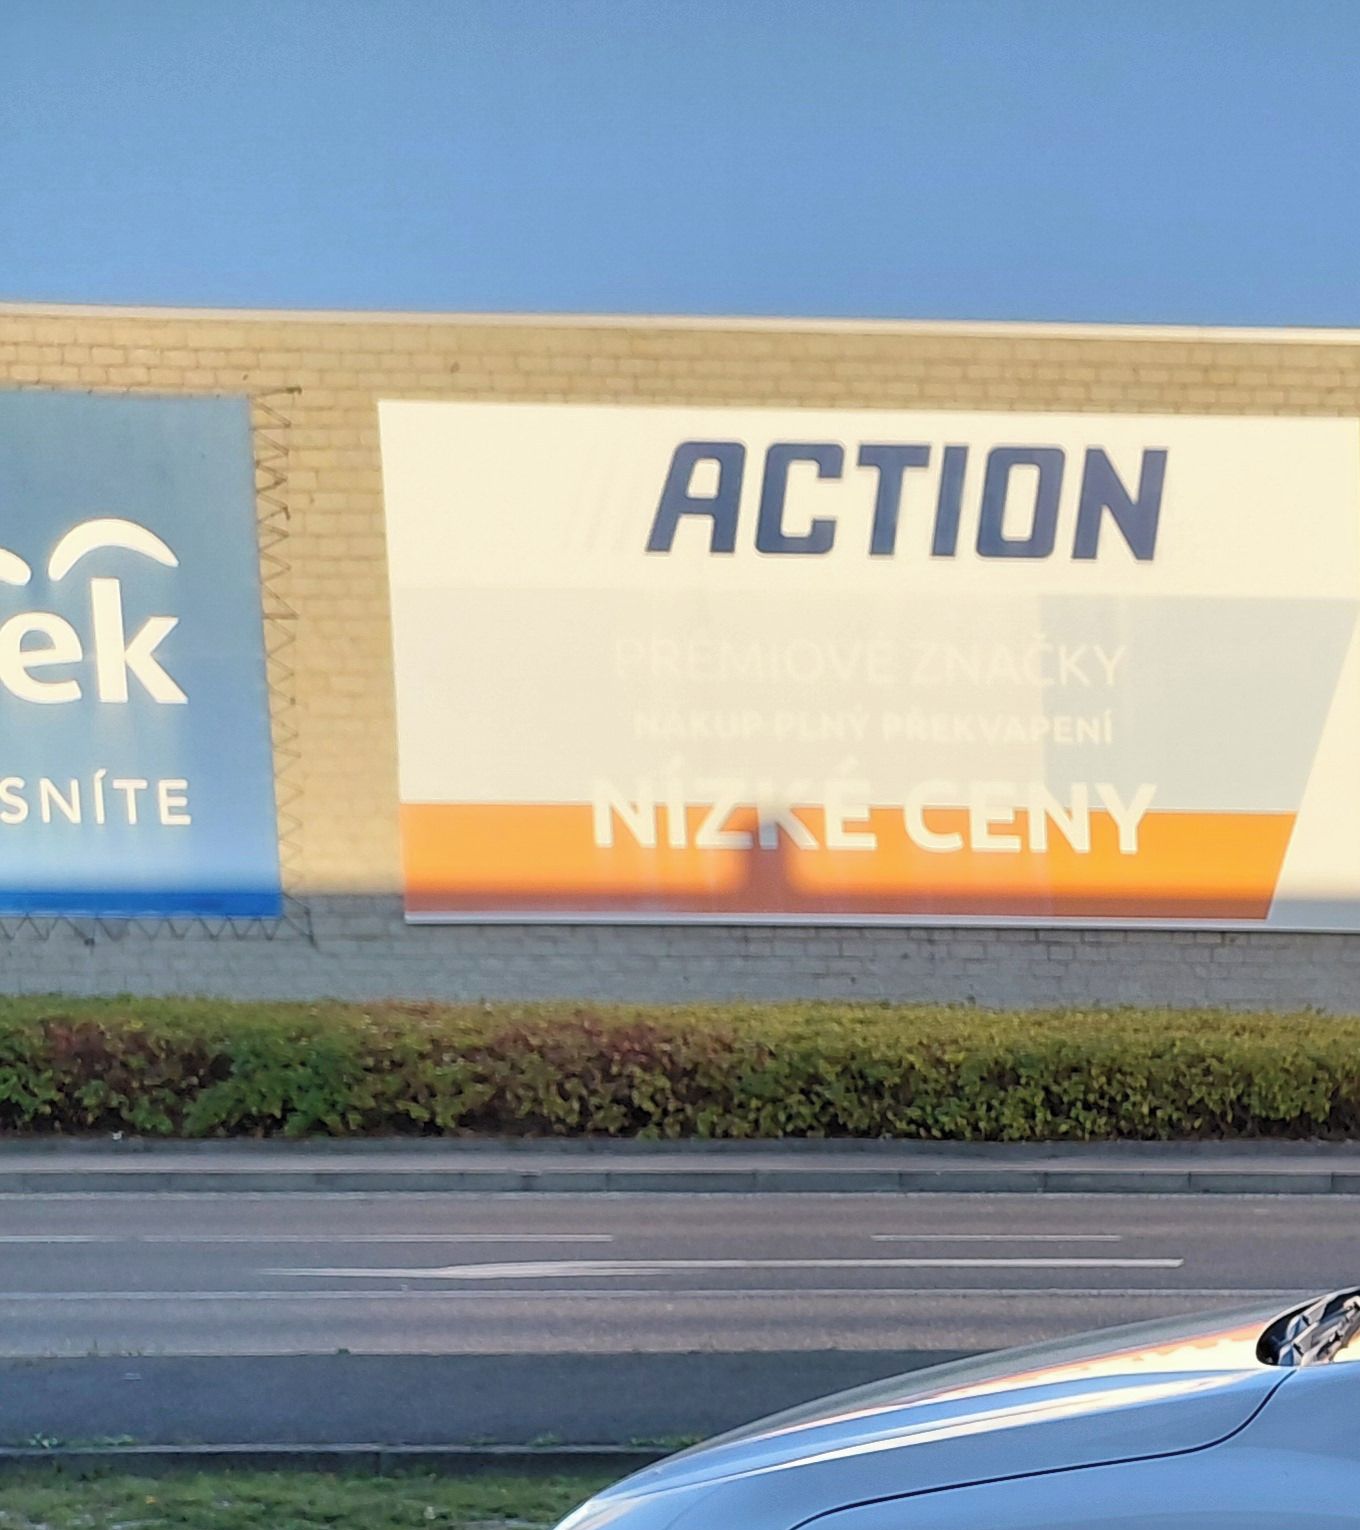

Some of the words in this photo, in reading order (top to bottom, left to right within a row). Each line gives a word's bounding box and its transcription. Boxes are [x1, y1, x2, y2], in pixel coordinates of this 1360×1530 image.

[645, 440, 1169, 562] ACTION
[909, 631, 1126, 686] ZNAČKY
[882, 706, 1114, 747] PŘEKVAPENÍ
[0, 768, 192, 826] SNÍTE
[592, 755, 878, 852] NÍZKÉ
[903, 779, 1158, 856] CENY
